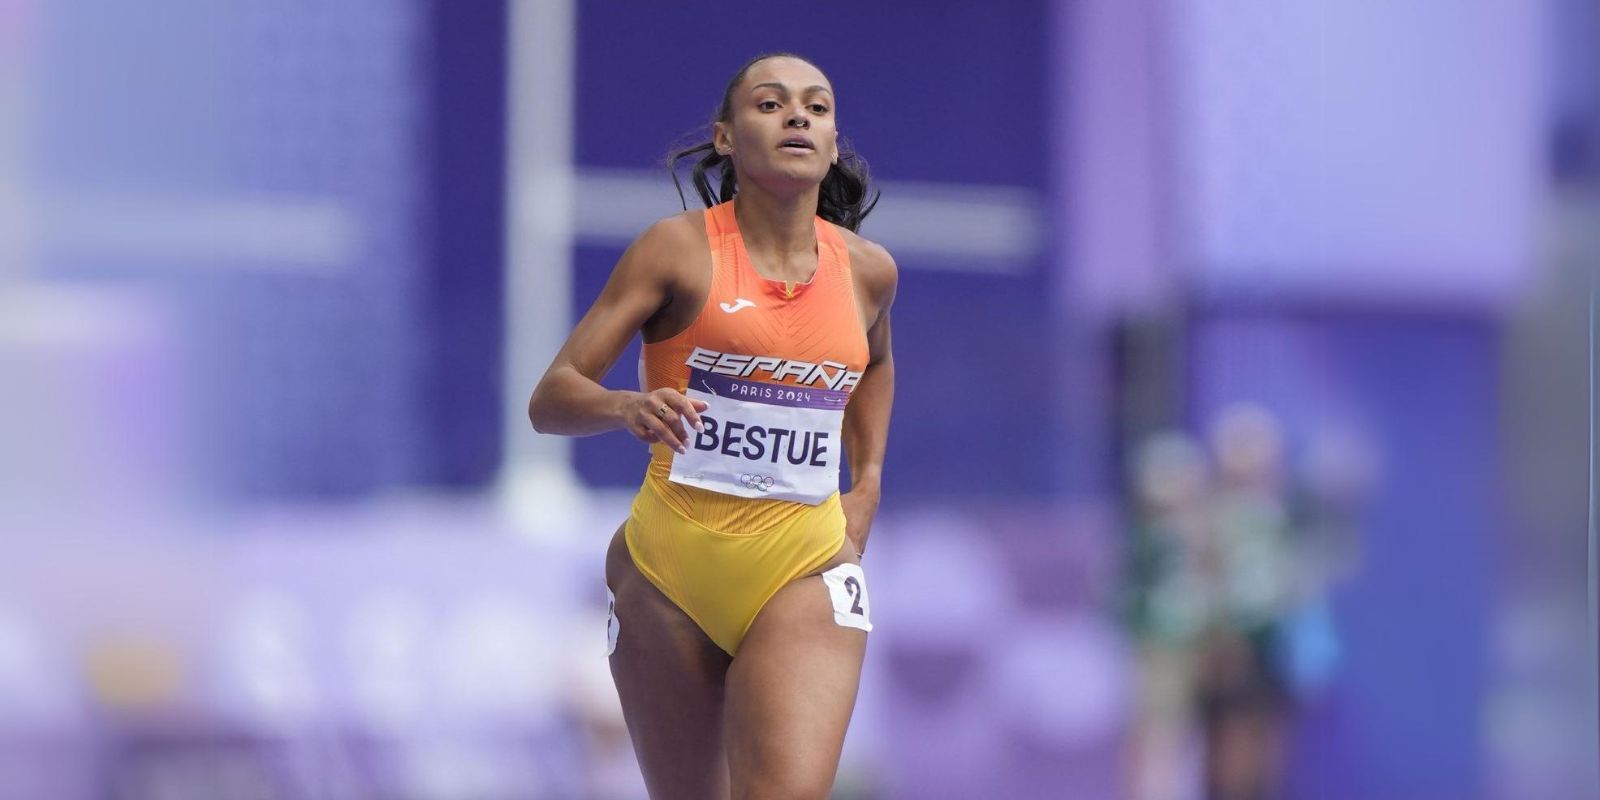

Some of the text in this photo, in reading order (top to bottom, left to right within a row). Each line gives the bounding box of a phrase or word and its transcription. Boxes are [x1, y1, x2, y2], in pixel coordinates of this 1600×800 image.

[685, 347, 863, 393] ESPAÑA
[776, 389, 811, 403] 2024
[694, 415, 829, 467] BESTUE
[844, 576, 863, 616] 2
